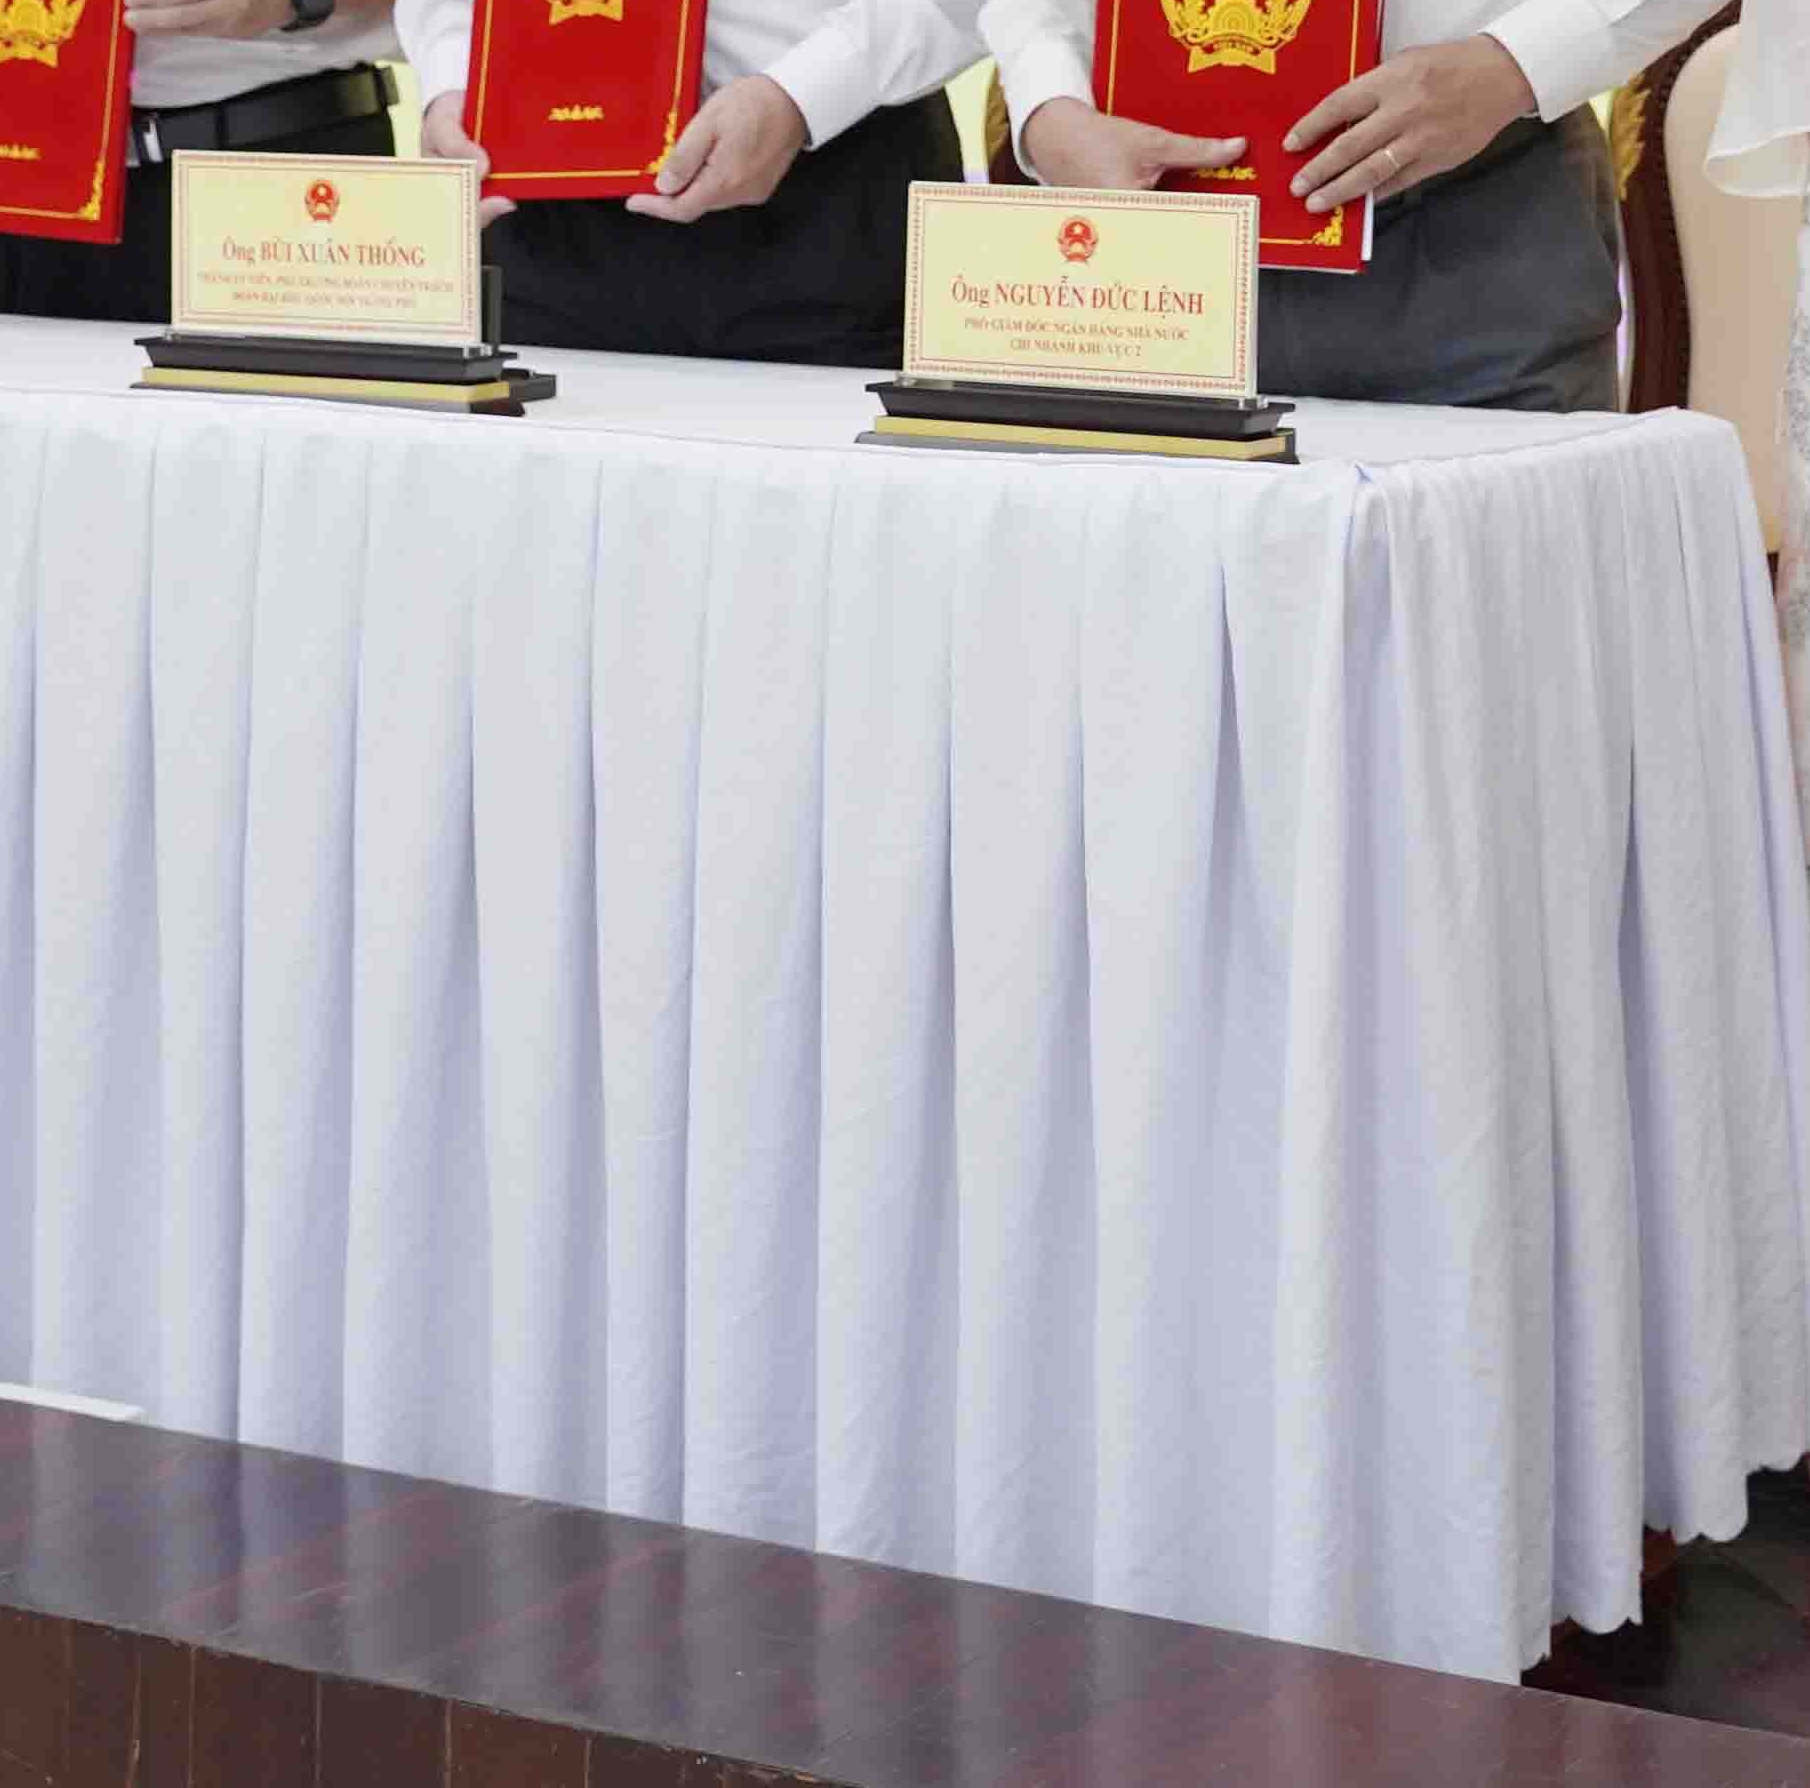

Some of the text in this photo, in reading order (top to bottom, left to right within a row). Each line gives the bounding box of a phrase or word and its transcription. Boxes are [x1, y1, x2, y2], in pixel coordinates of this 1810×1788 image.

[221, 236, 255, 265] Ông
[951, 274, 1206, 320] Ông NGUYỄN ĐỨC LỆNH
